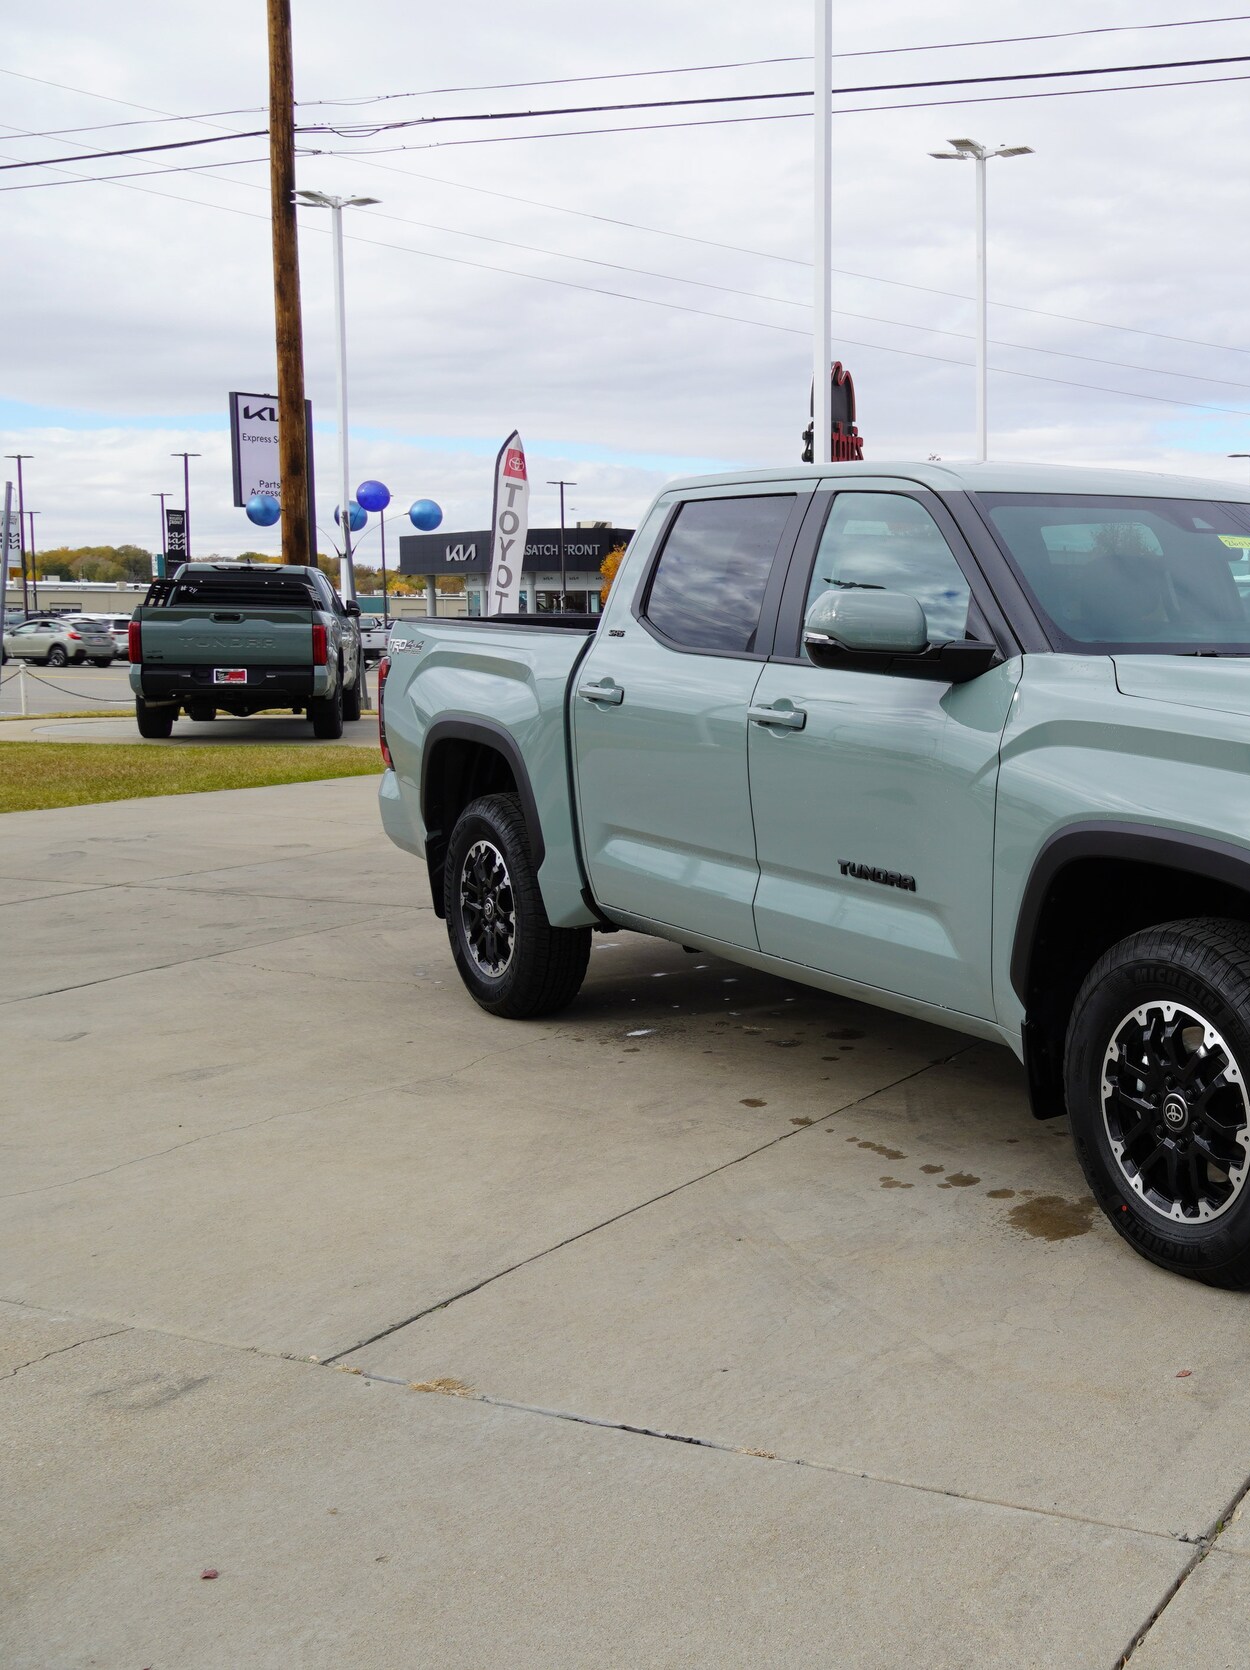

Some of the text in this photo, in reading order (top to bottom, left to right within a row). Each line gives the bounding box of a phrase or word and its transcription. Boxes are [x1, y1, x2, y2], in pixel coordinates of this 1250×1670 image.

[243, 405, 279, 422] KI
[242, 433, 272, 443] Express
[259, 480, 281, 489] Parts
[445, 544, 477, 561] KIA
[495, 483, 523, 614] TOYOT
[524, 544, 559, 555] SATCH
[178, 636, 276, 648] TUNDRA
[837, 858, 917, 892] TUNDRA
[1134, 966, 1224, 1017] MICHELIN
